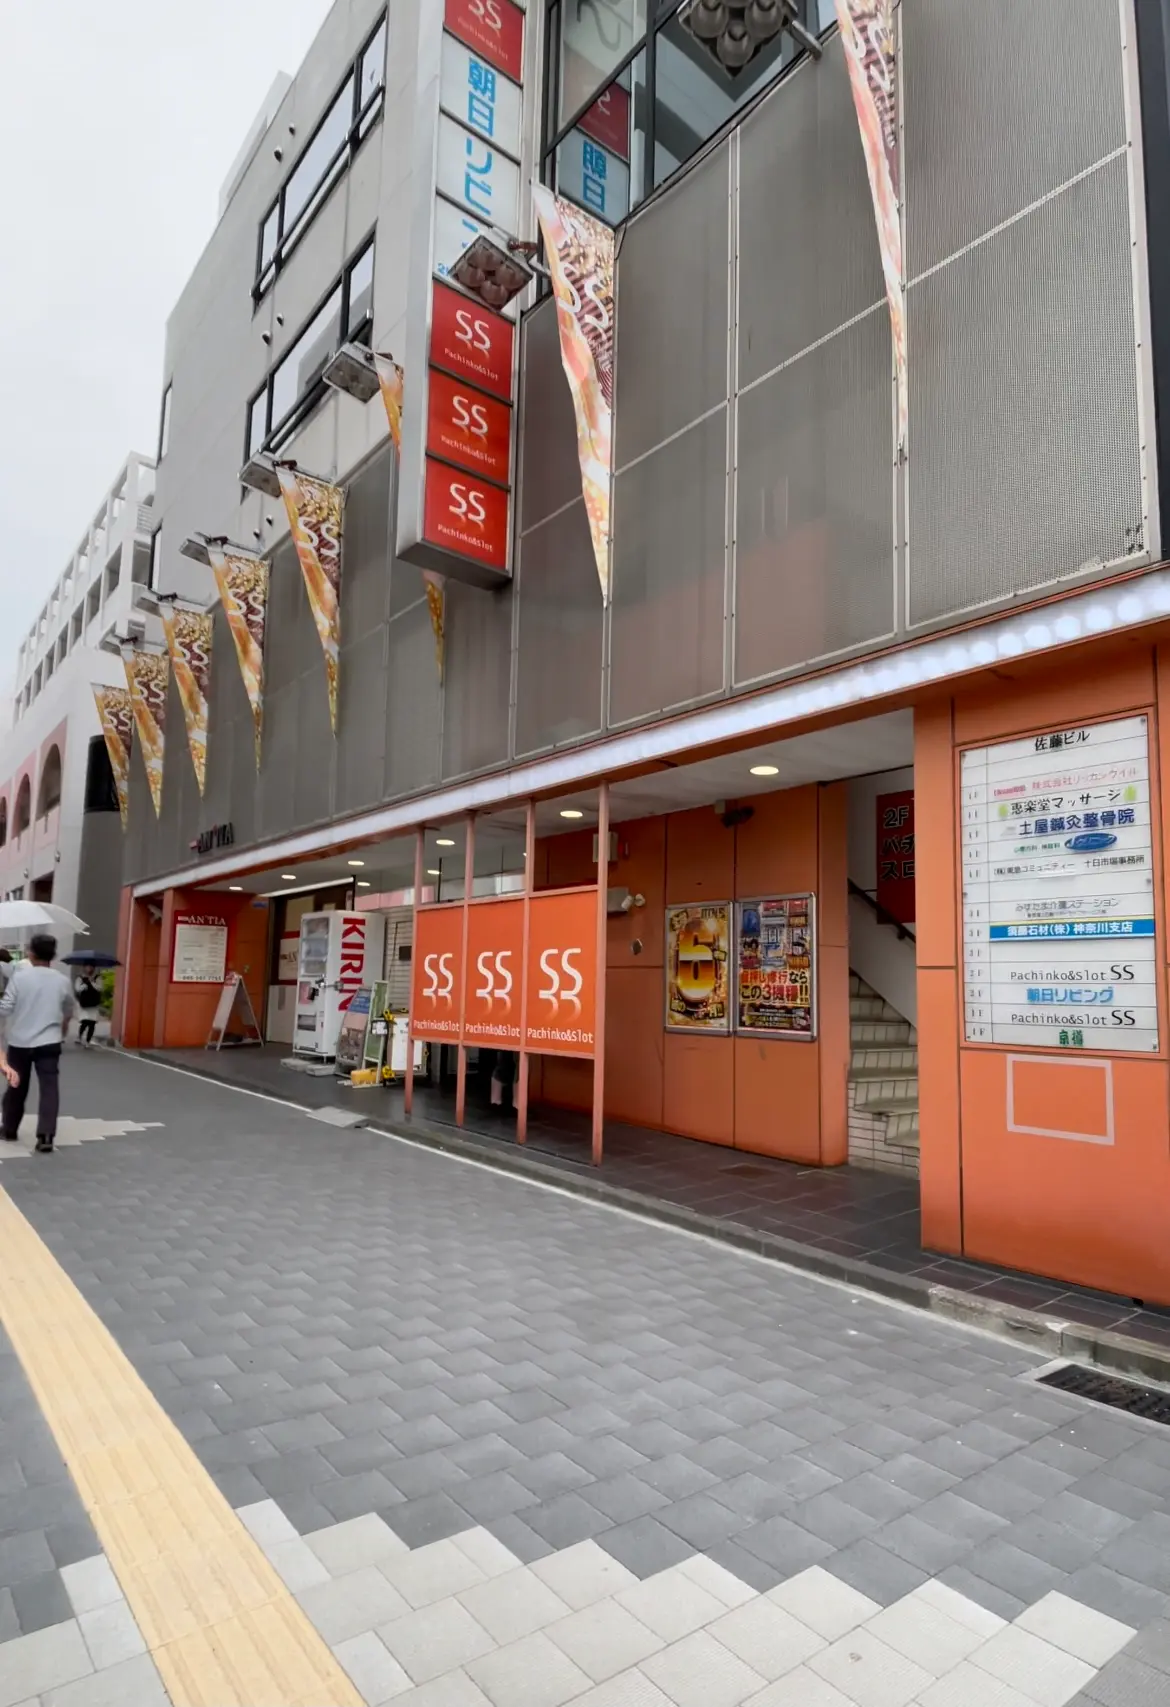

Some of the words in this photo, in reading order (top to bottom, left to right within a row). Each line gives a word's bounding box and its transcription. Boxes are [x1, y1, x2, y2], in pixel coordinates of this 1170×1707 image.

[455, 310, 491, 350] SS
[444, 347, 499, 382] Pachinko&Slot
[452, 395, 488, 436] SS
[441, 434, 497, 466] Pachinko&Slot
[449, 483, 486, 523] SS
[297, 515, 338, 558] SS
[437, 524, 494, 552] Pachinko&Slot
[228, 588, 264, 624] SS
[173, 638, 209, 667] SS
[131, 677, 165, 702] SS
[1034, 730, 1091, 751] 佐藤ビル
[883, 805, 910, 829] 2F
[423, 953, 454, 996] SS
[476, 951, 513, 997] SS
[539, 948, 583, 1000] SS
[1010, 970, 1107, 981] Pachinko&Slot
[1110, 964, 1135, 981] SS
[1026, 986, 1114, 1003] 朝日リビング
[413, 1019, 460, 1032] Pachinko&Slot
[465, 1023, 521, 1037] Pachinko&Slot
[1011, 1013, 1108, 1026] Pachinko&Slot
[1111, 1009, 1136, 1026] SS
[527, 1028, 594, 1043] Pachinko&Slot
